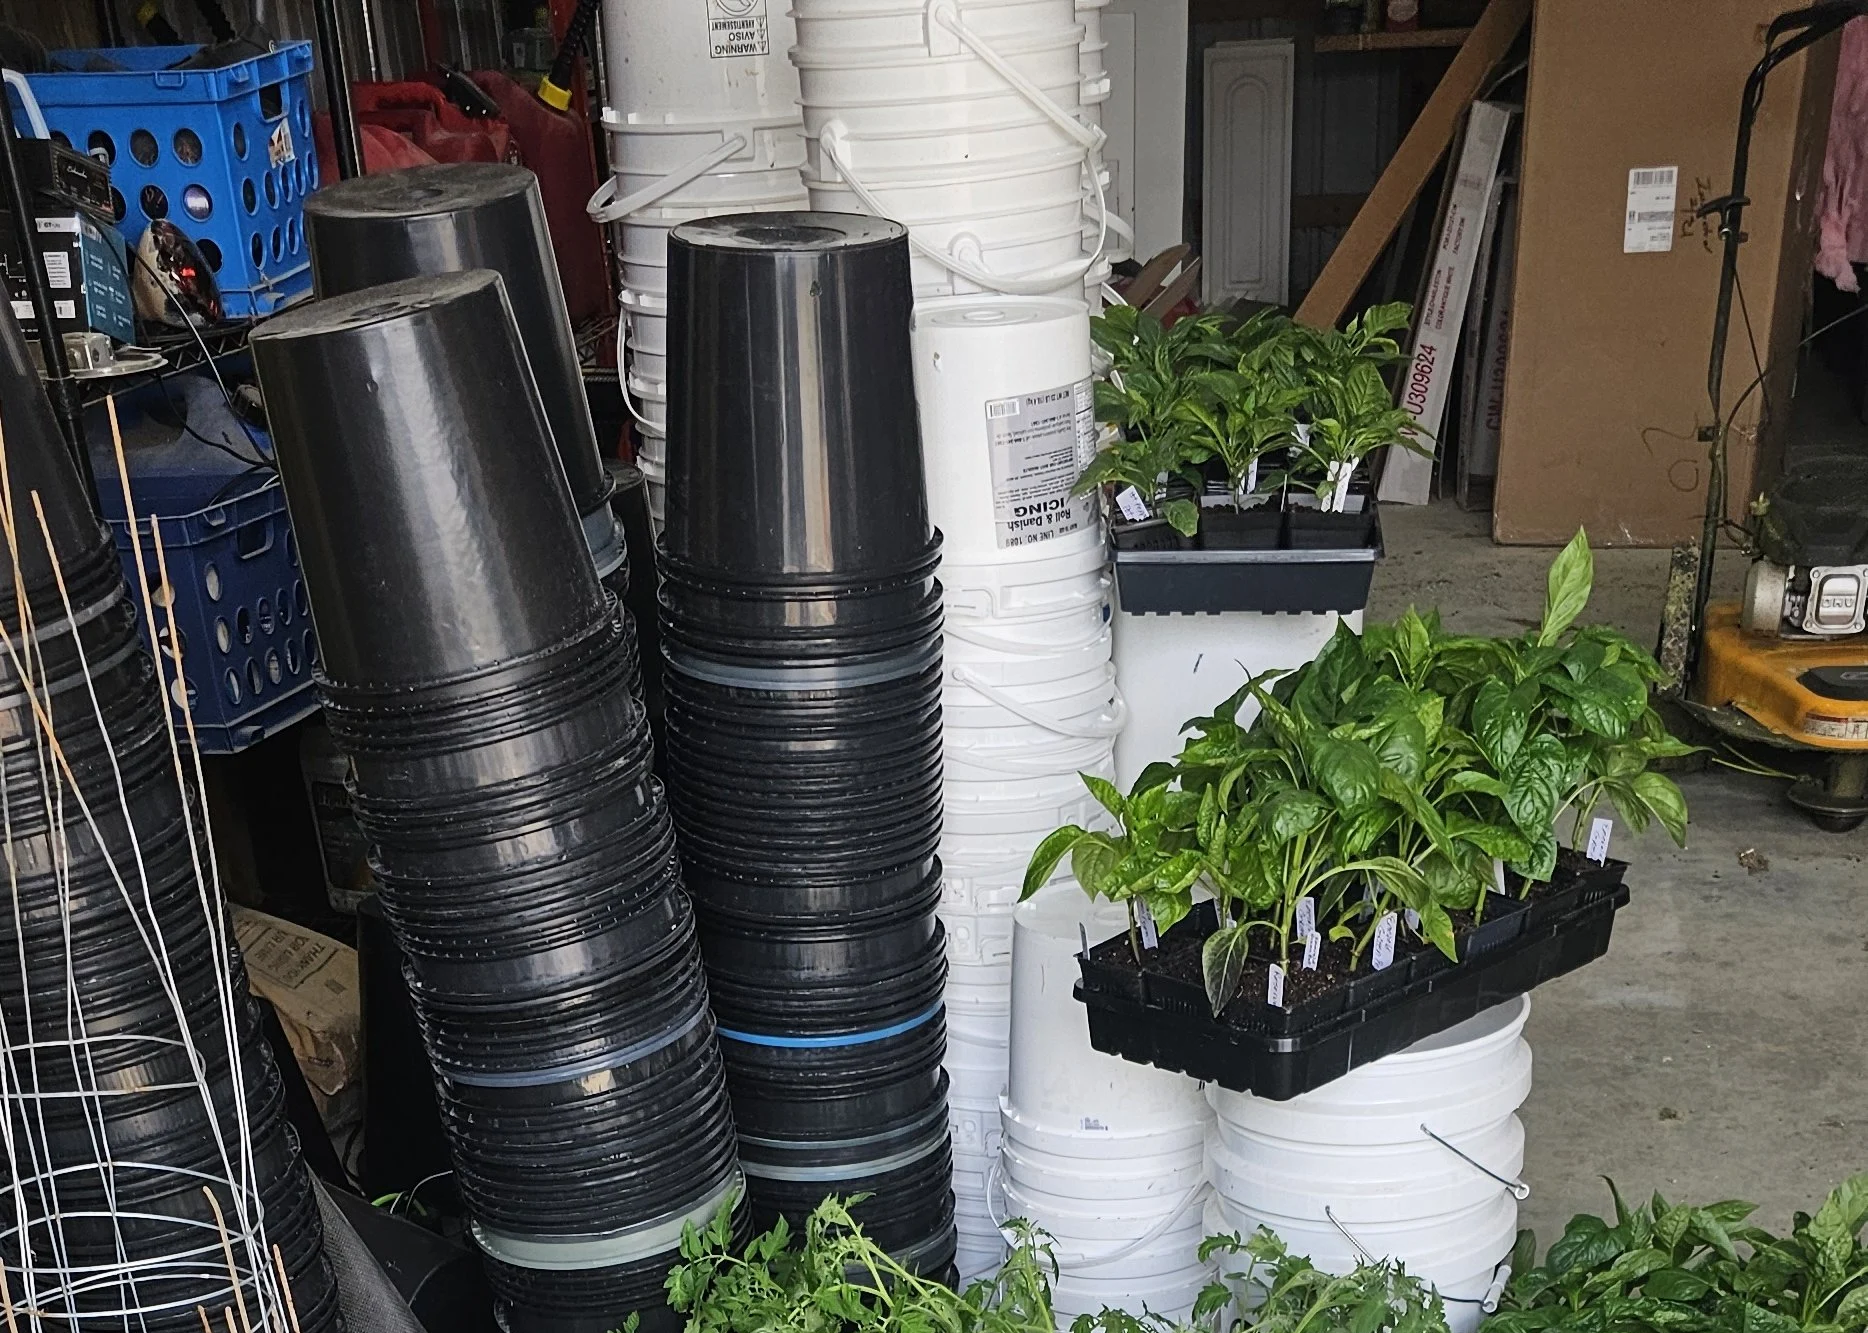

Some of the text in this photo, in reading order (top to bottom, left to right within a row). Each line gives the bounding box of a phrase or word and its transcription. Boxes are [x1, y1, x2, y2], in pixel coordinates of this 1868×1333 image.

[712, 20, 754, 31] AVERTISSEMENT
[728, 32, 755, 42] AVISO
[715, 44, 757, 54] WARNING
[1014, 498, 1064, 517] ICING
[1046, 513, 1053, 524] &
[1055, 508, 1071, 522] Roll
[1008, 516, 1042, 531] Danish
[1039, 529, 1054, 541] LINE
